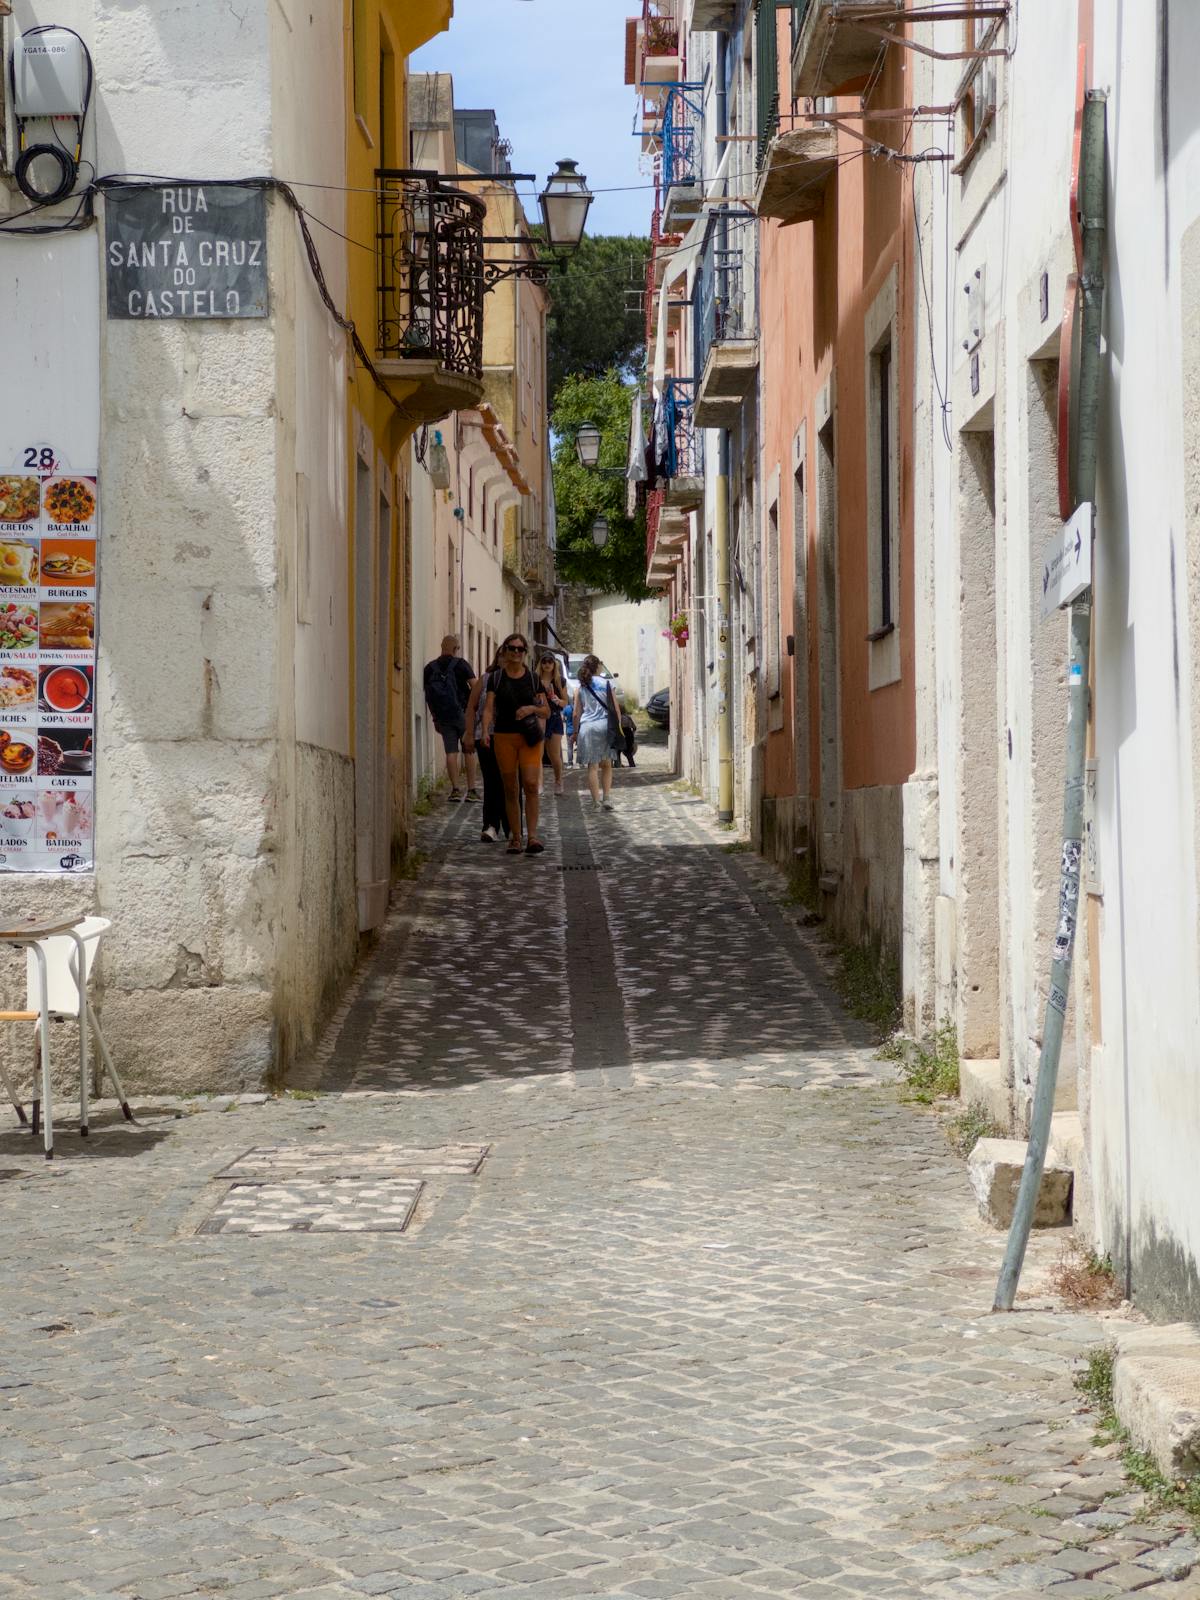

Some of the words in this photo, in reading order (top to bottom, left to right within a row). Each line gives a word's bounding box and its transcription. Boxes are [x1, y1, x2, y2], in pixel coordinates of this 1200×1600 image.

[23, 46, 66, 54] YGA14-086
[162, 188, 208, 213] RUA
[172, 216, 195, 234] DE
[109, 240, 189, 267] SANTA
[199, 240, 262, 266] CRUZ
[173, 268, 196, 286] DO
[128, 290, 240, 317] CASTELO
[24, 448, 54, 467] 28
